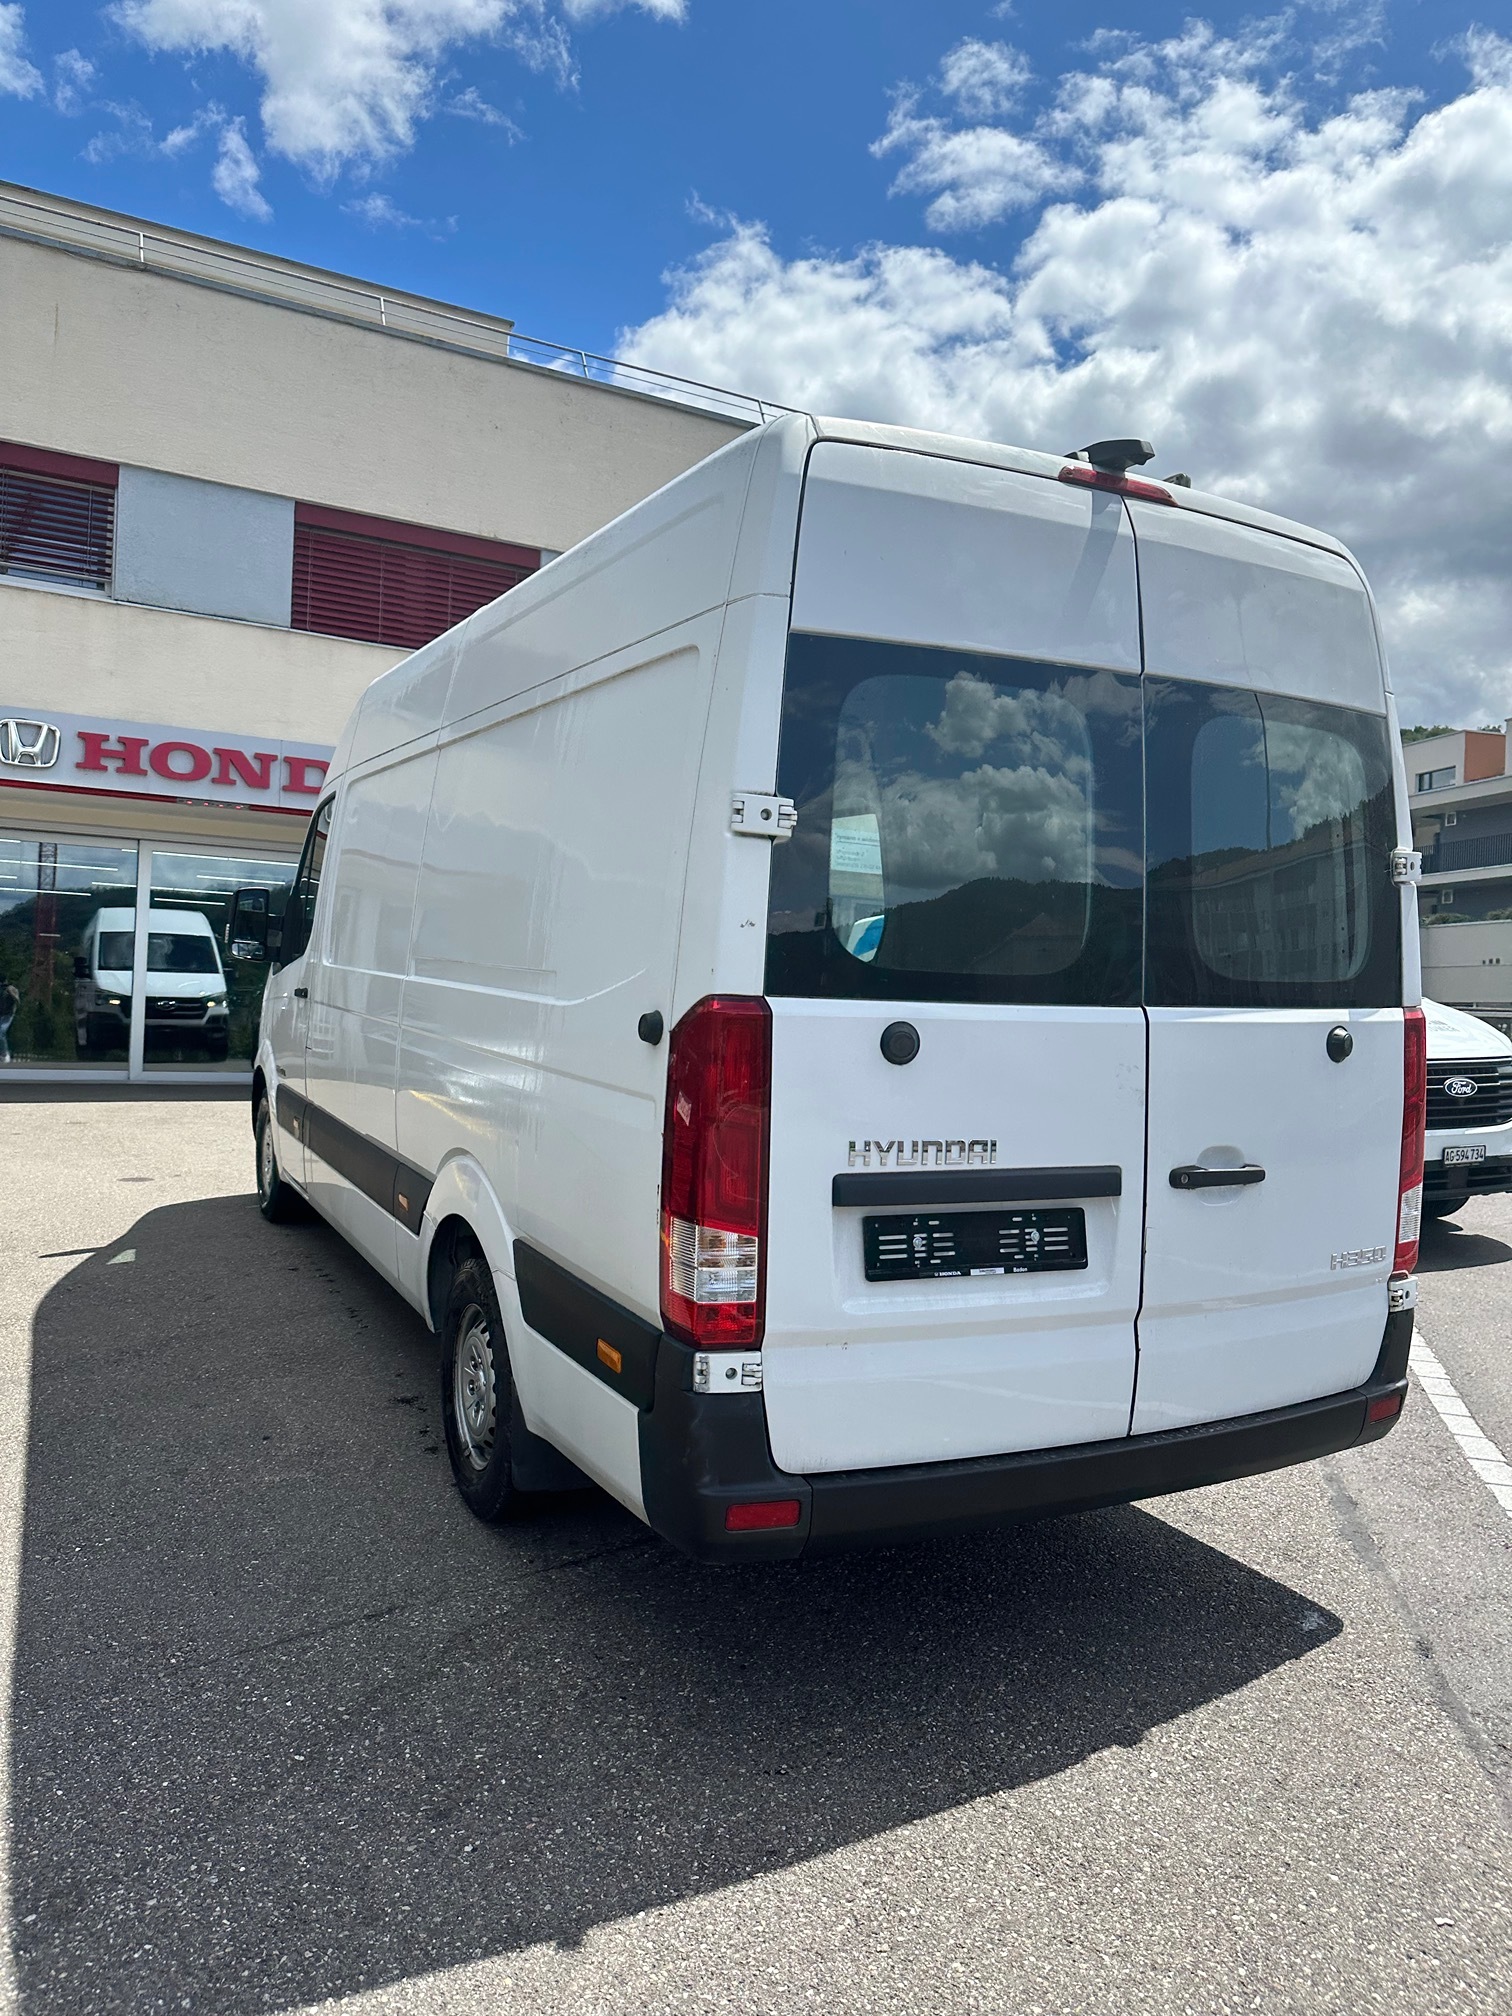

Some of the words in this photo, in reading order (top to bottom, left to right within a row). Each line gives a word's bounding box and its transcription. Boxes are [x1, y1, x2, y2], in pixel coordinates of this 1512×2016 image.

[1451, 1080, 1472, 1094] Ford
[848, 1139, 997, 1166] HYUNDAI
[1330, 1245, 1387, 1270] H350
